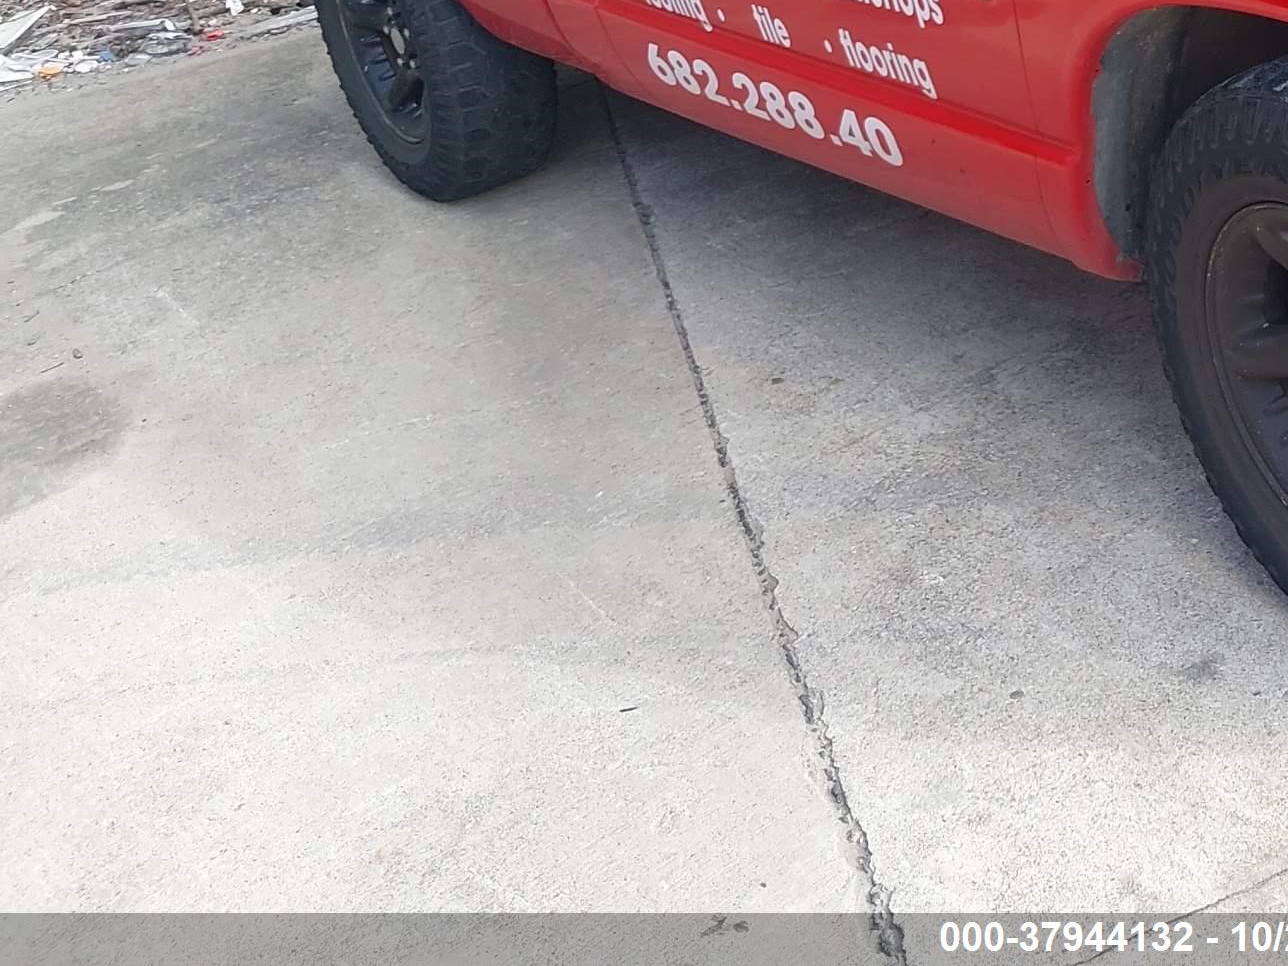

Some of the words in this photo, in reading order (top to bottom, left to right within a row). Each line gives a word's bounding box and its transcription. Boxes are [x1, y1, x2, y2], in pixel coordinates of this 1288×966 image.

[647, 42, 904, 167] 682.288.40
[751, 3, 792, 48] tile
[837, 27, 939, 100] flooring
